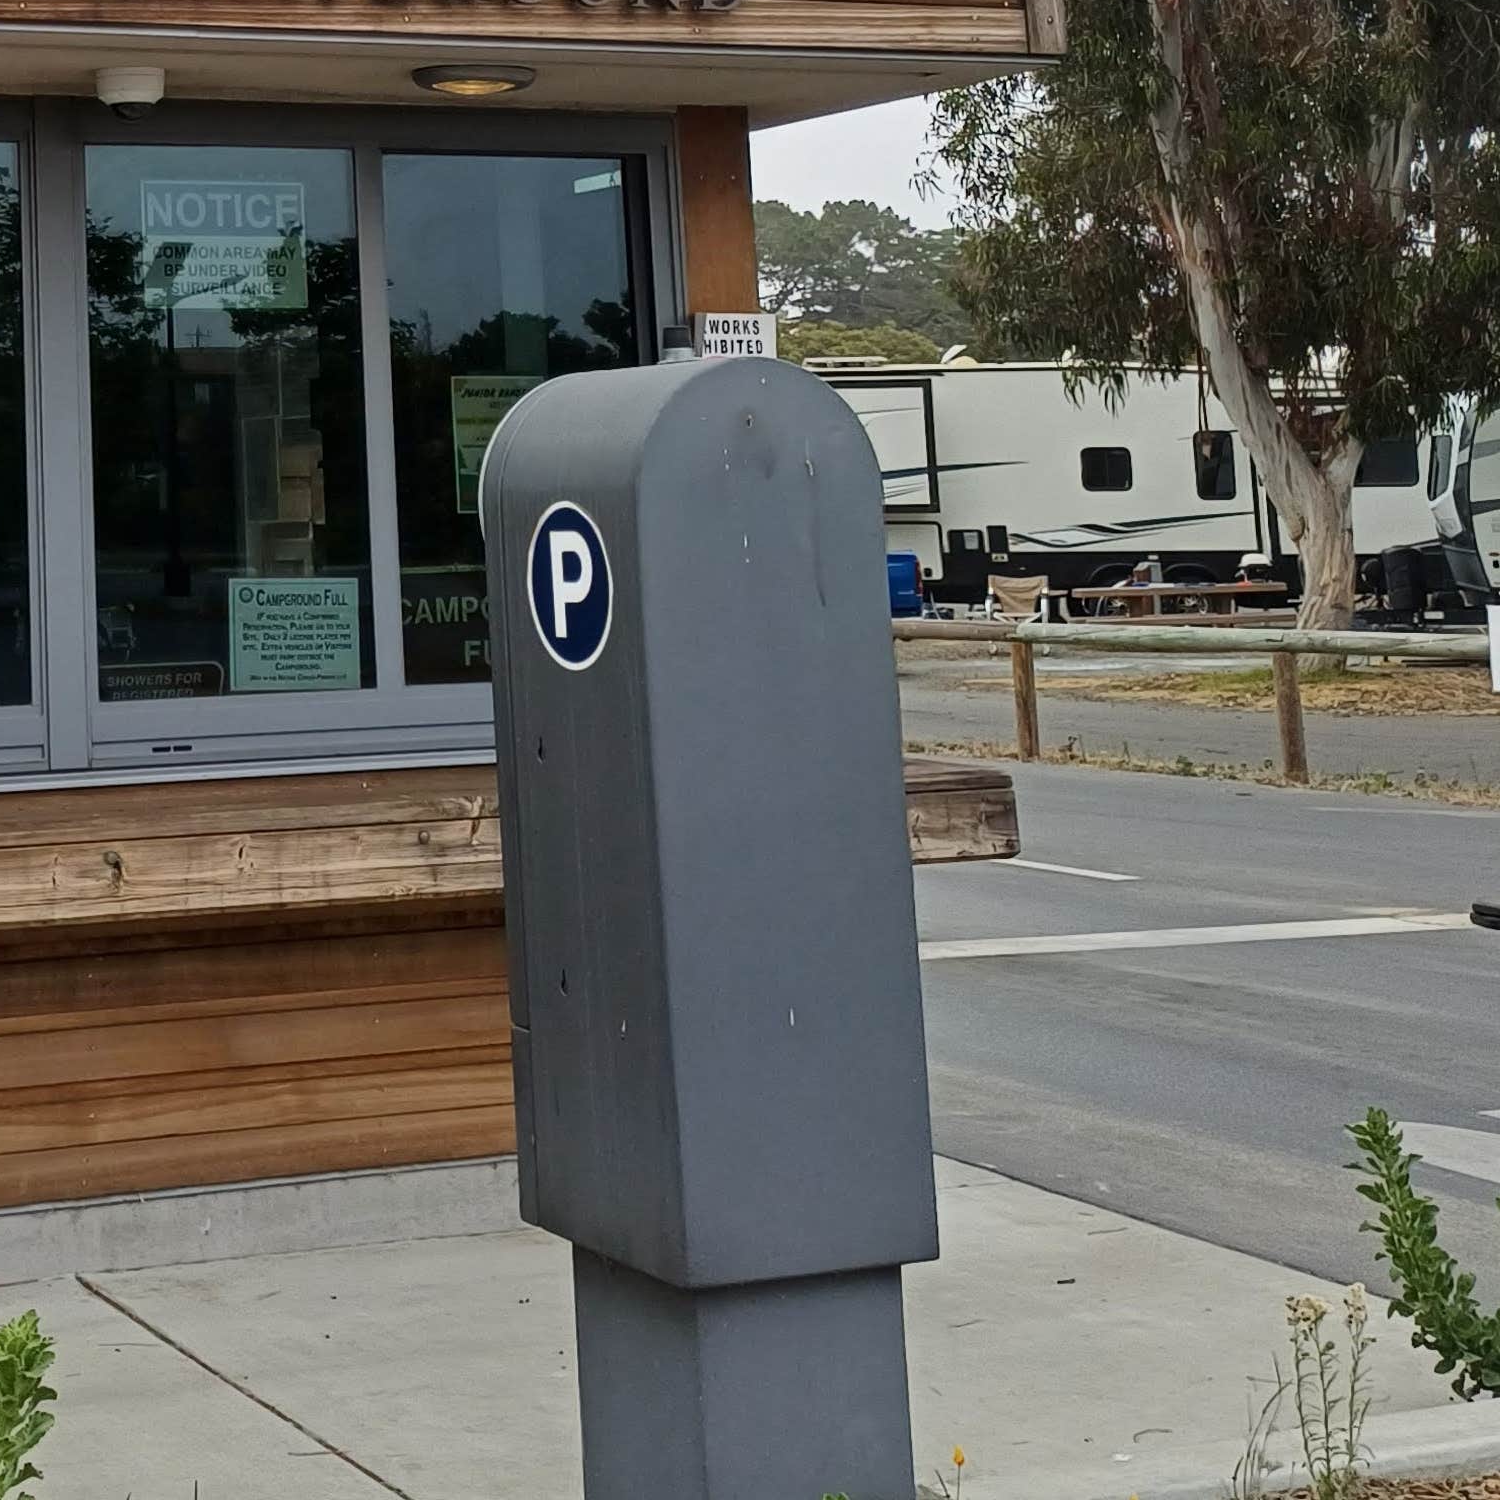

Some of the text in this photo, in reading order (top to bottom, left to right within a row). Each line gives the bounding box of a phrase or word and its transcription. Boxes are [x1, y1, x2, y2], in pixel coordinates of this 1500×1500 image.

[148, 192, 299, 229] NOTICE
[154, 245, 297, 260] COMMON AREA MAY
[164, 263, 287, 277] BE UNDER VIDEO
[171, 280, 285, 296] SURVEILLANCE
[704, 319, 760, 335] WORKS
[549, 530, 593, 638] P
[256, 589, 349, 606] CAMPGROUND FULL
[175, 672, 203, 685] FOR
